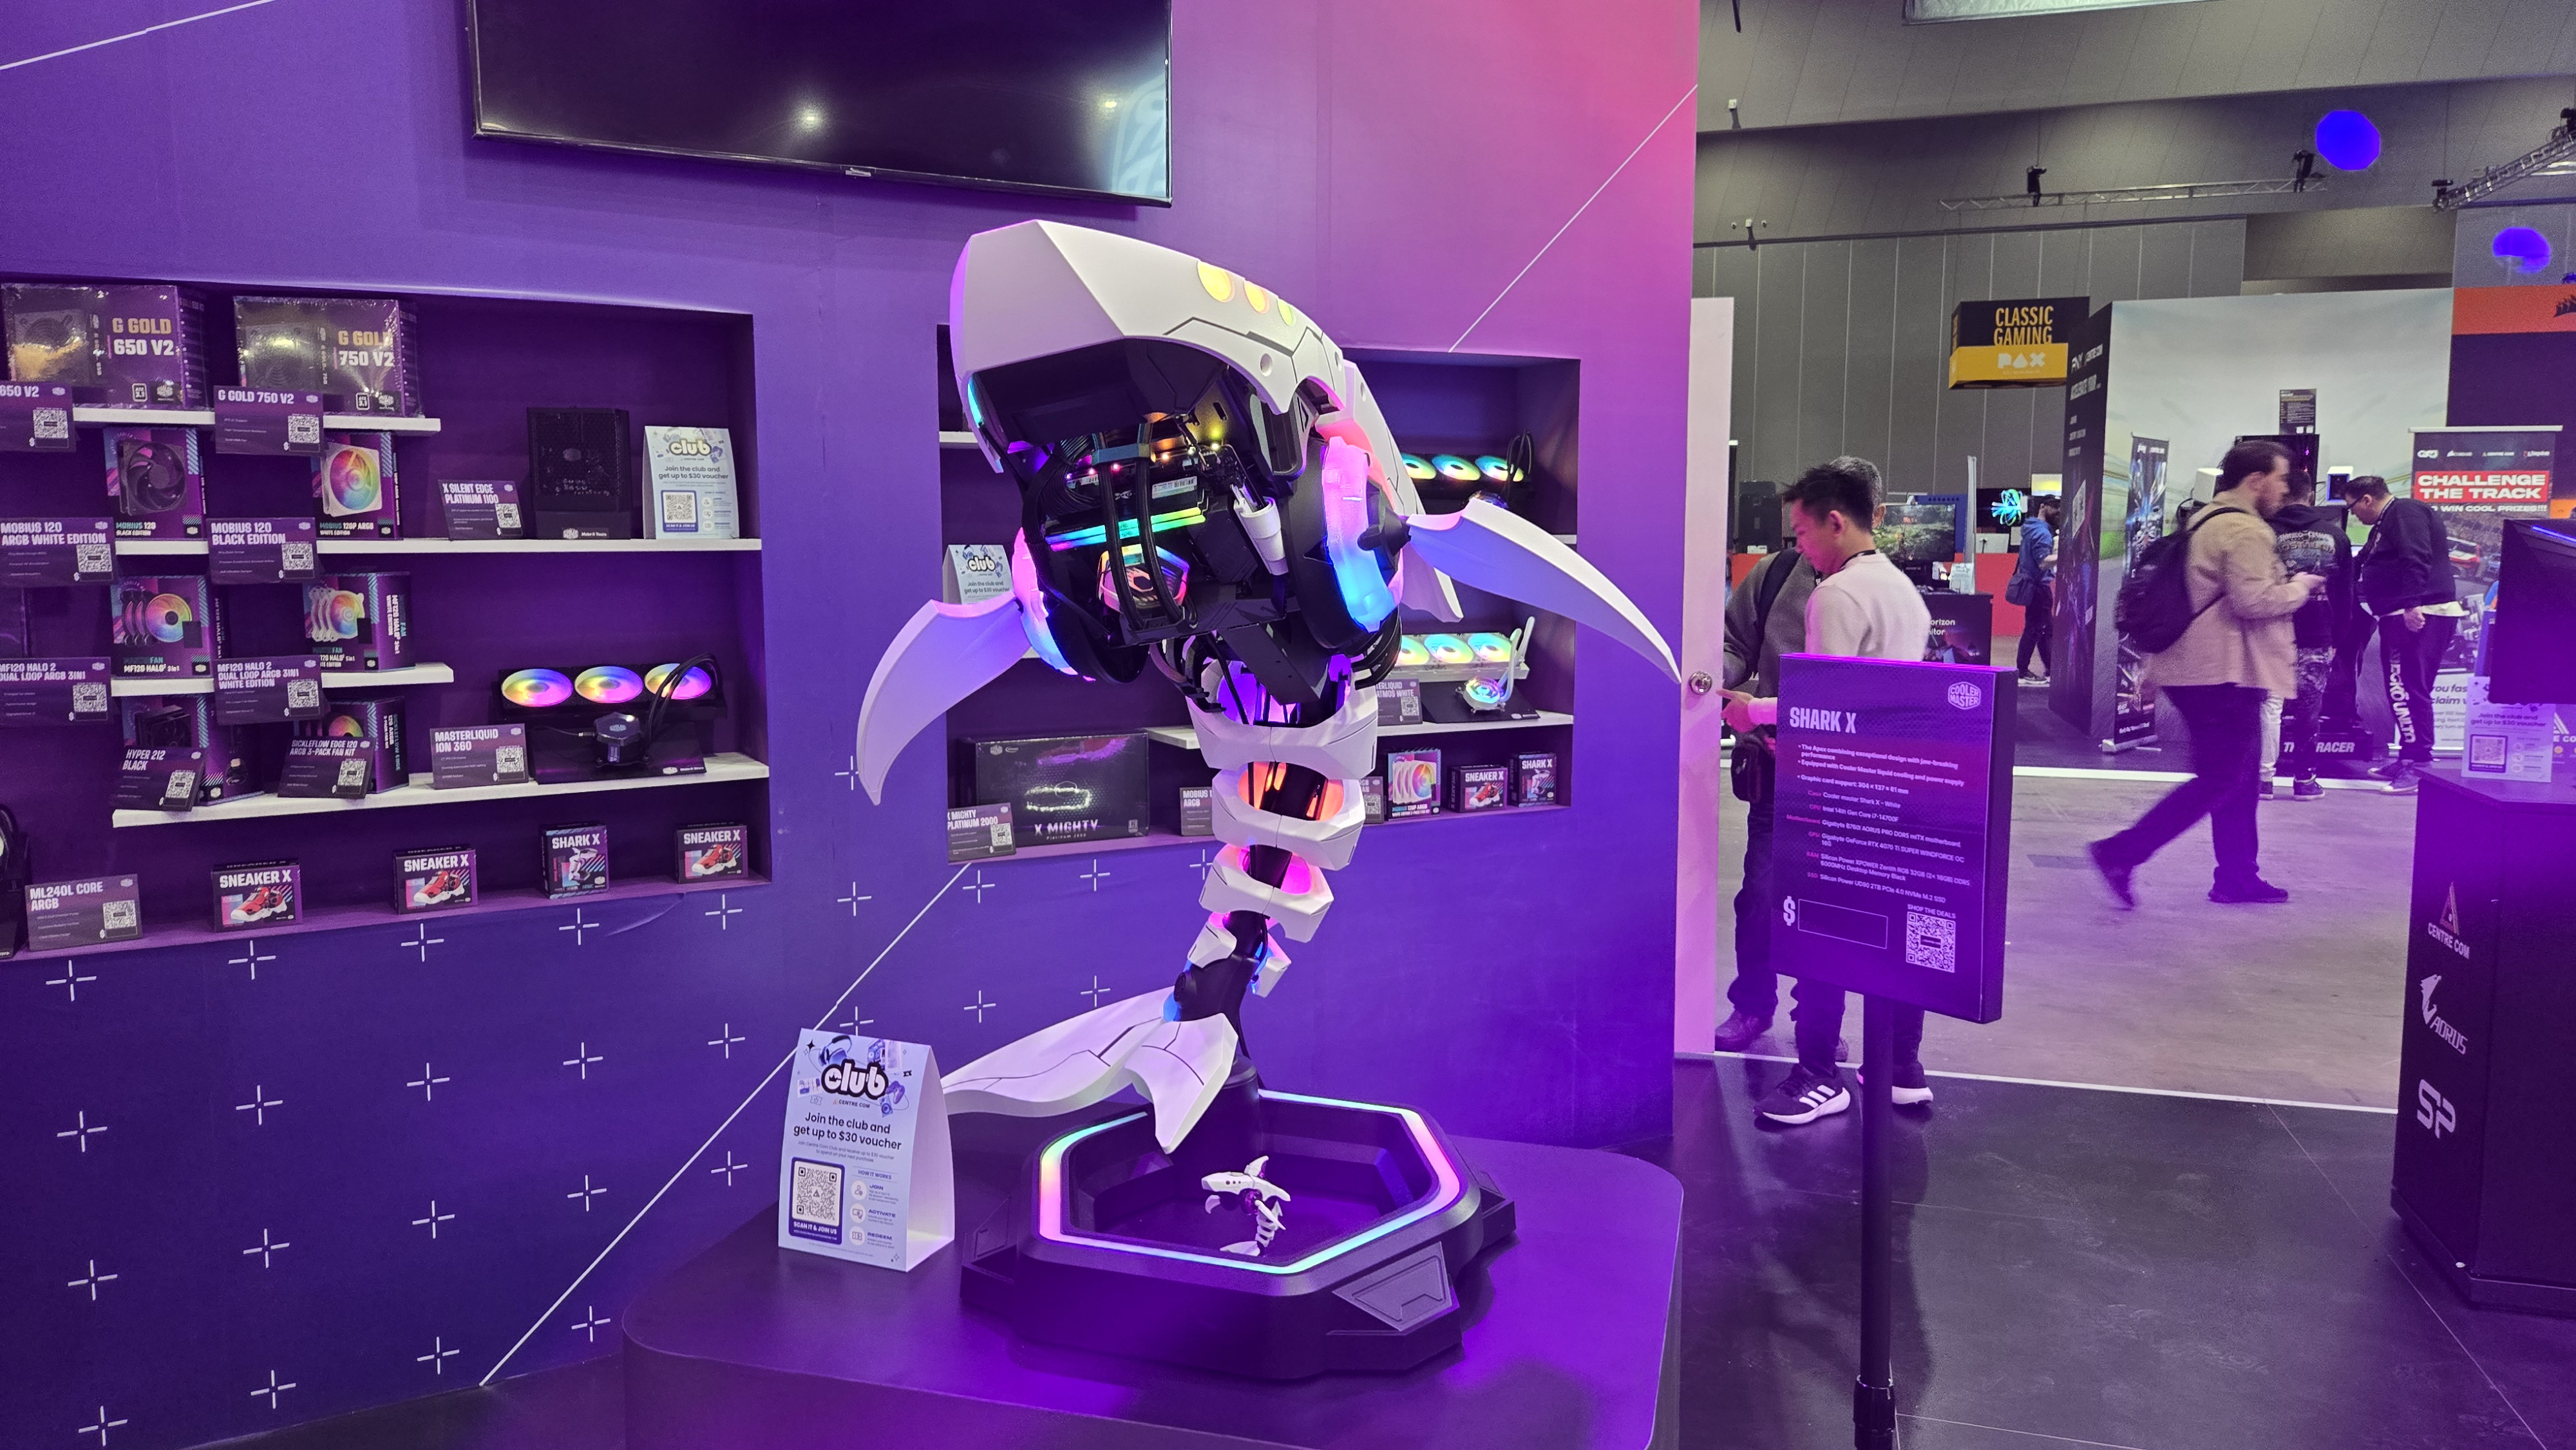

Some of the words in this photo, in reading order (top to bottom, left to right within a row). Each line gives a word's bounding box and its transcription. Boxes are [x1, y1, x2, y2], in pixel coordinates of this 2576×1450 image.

[1996, 306, 2054, 326] CLASSIC
[112, 318, 123, 333] G
[128, 318, 171, 334] GOLD
[339, 330, 348, 344] G
[352, 331, 393, 346] GOLD
[1994, 326, 2052, 346] GAMING
[113, 339, 147, 355] 650
[151, 340, 175, 355] V2
[339, 351, 368, 366] 750
[372, 351, 394, 366] V2
[24, 386, 39, 397] V2
[218, 390, 225, 400] G
[228, 390, 254, 402] GOLD
[257, 391, 278, 403] 750
[280, 392, 294, 404] V2
[669, 438, 712, 456] club
[2418, 475, 2546, 486] CHALLENGE
[442, 484, 449, 493] X
[449, 484, 474, 493] SILENT
[475, 484, 494, 494] EDGE
[2420, 488, 2463, 499] THE
[2468, 487, 2541, 499] TRACK
[444, 494, 482, 504] PLATINUM
[483, 494, 499, 504] 1100
[1, 522, 42, 534] MOBIUS
[44, 522, 62, 533] 120
[211, 522, 252, 534] MOBIUS
[254, 522, 272, 533] 120
[1, 534, 30, 545] ARGB
[32, 533, 65, 545] WHITE
[66, 532, 107, 544] EDITION
[212, 534, 251, 545] BLACK
[252, 533, 286, 545] EDITION
[967, 555, 996, 572] club
[26, 663, 48, 672] HALO
[50, 663, 56, 671] 2
[218, 663, 243, 672] MF120
[244, 663, 265, 671] HALO
[21, 672, 43, 681] LOOP
[218, 671, 238, 681] DUAL
[240, 671, 260, 679] LOOP
[261, 670, 281, 679] ARGB
[219, 680, 244, 689] WHITE
[245, 679, 275, 688] EDITION
[1396, 689, 1414, 697] WHITE
[1950, 684, 1978, 697] COOLER
[1950, 695, 1978, 707] MASTER
[1790, 707, 1842, 733] SHARK
[1845, 712, 1857, 733] X
[435, 728, 498, 742] MASTERLIQUID
[307, 748, 331, 757] 3-PACK
[436, 742, 453, 753] ION
[454, 741, 472, 752] 360
[2316, 742, 2355, 752] RACER
[126, 749, 151, 760] HYPER
[151, 750, 166, 760] 212
[122, 760, 147, 771] BLACK
[1522, 760, 1546, 769] SHARK
[1546, 759, 1553, 767] X
[1465, 771, 1497, 782] SNEAKER
[1499, 771, 1504, 780] X
[1801, 774, 1821, 782] Graphic
[1183, 790, 1208, 798] MOBIUS
[1184, 798, 1200, 807] ARGB
[951, 809, 976, 820] MIGHTY
[947, 818, 980, 830] PLATINUM
[981, 816, 998, 826] 2000
[1034, 823, 1043, 836] X
[1047, 820, 1099, 834] MIGHTY
[1822, 820, 1845, 828] Gigabyte
[552, 834, 589, 849] SHARK
[592, 834, 601, 845] X
[683, 831, 731, 844] SNEAKER
[733, 829, 741, 841] X
[1821, 833, 1845, 842] Gigabyte
[1900, 846, 1919, 855] SUPER
[404, 855, 458, 873] SNEAKER
[459, 854, 469, 866] X
[1821, 853, 1837, 862] Silicon
[220, 870, 279, 889] SNEAKER
[282, 870, 292, 883] X
[1820, 874, 1837, 882] Silicon
[30, 884, 74, 900] ML240L
[76, 881, 104, 895] CORE
[31, 898, 59, 911] ARGB
[1783, 896, 1795, 927] $
[1924, 907, 1936, 915] THE
[1937, 909, 1956, 919] DEALS
[2428, 923, 2453, 949] CENTRE
[2454, 939, 2470, 959] COM
[2430, 1016, 2468, 1055] AORUS
[822, 1059, 889, 1100] club
[2417, 1079, 2456, 1139] SP
[805, 1112, 826, 1124] Join
[828, 1116, 844, 1127] the
[846, 1118, 868, 1131] club
[870, 1124, 891, 1134] and
[793, 1125, 810, 1136] get
[812, 1129, 825, 1140] up
[827, 1129, 837, 1139] to
[838, 1130, 857, 1142] $30
[859, 1135, 902, 1150] voucher
[868, 1209, 896, 1218] ACTIVATE
[867, 1232, 893, 1241] REDEEM
